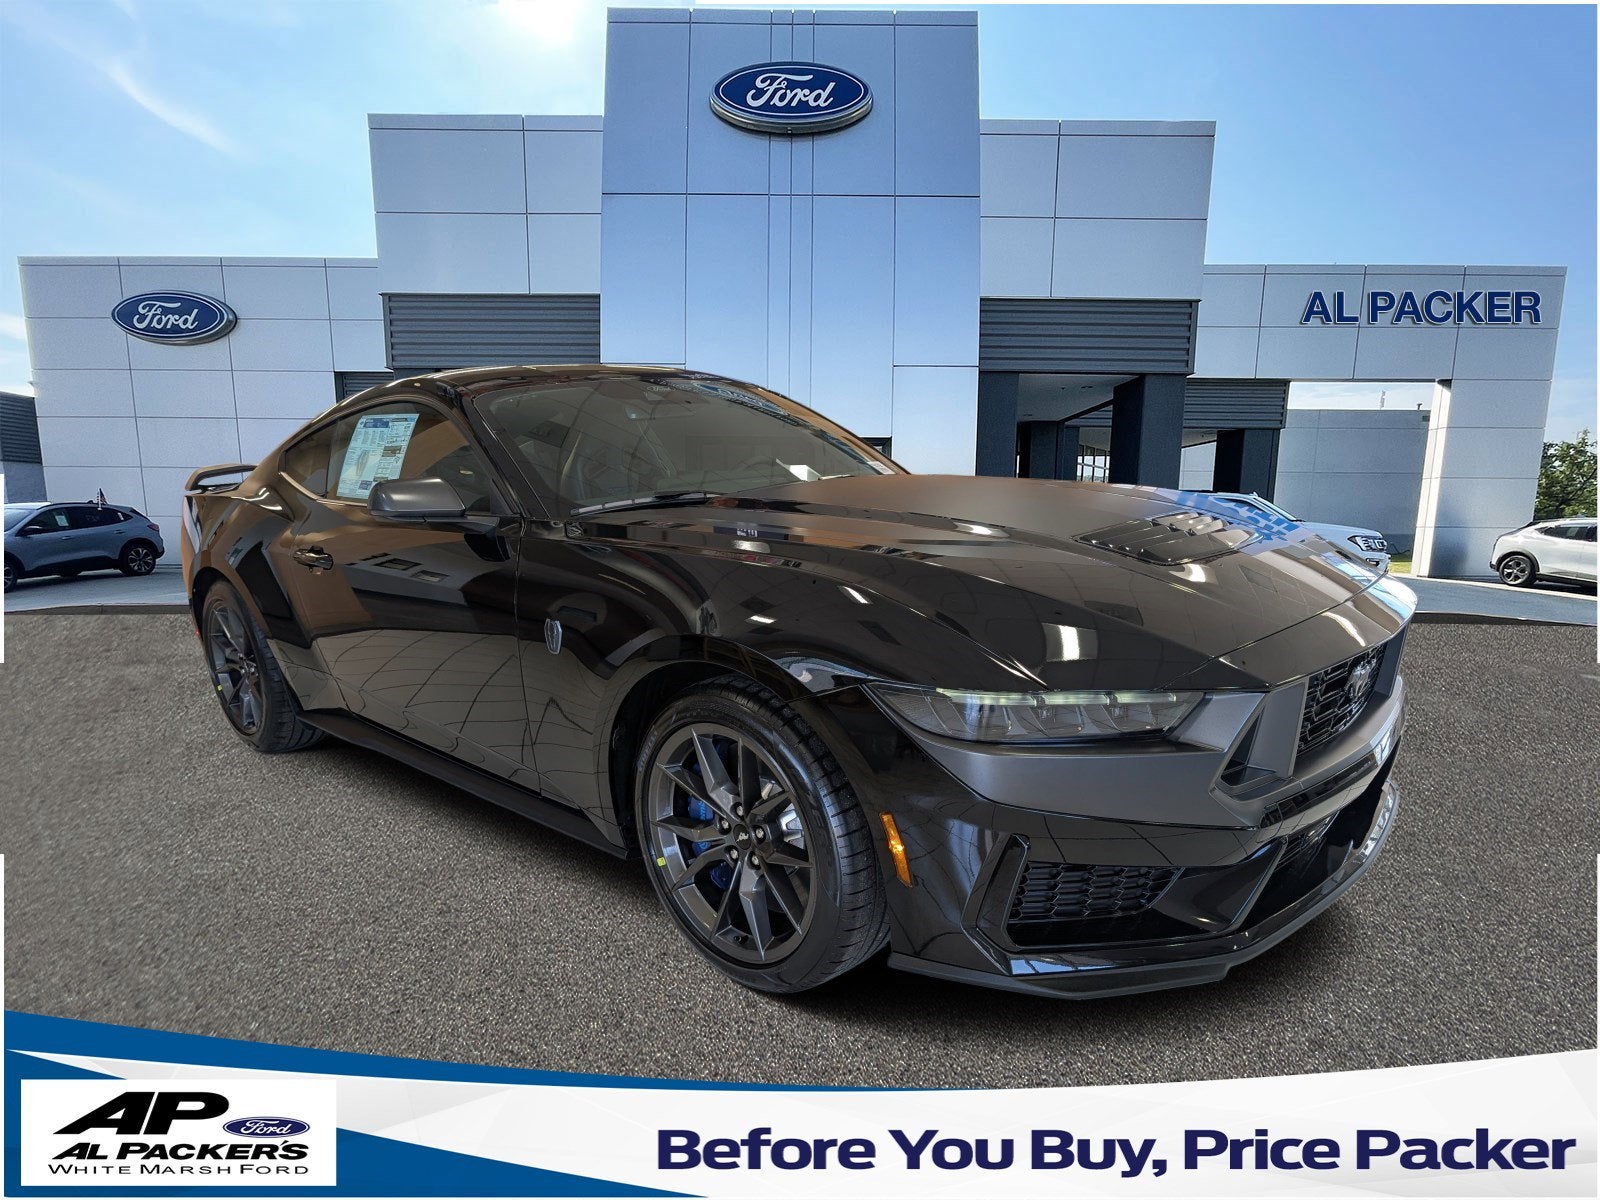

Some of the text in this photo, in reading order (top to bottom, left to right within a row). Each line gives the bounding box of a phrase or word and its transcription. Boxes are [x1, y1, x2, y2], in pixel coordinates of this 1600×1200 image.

[746, 73, 836, 107] Ford
[133, 301, 199, 329] Ford
[1301, 290, 1542, 325] AL PACKER
